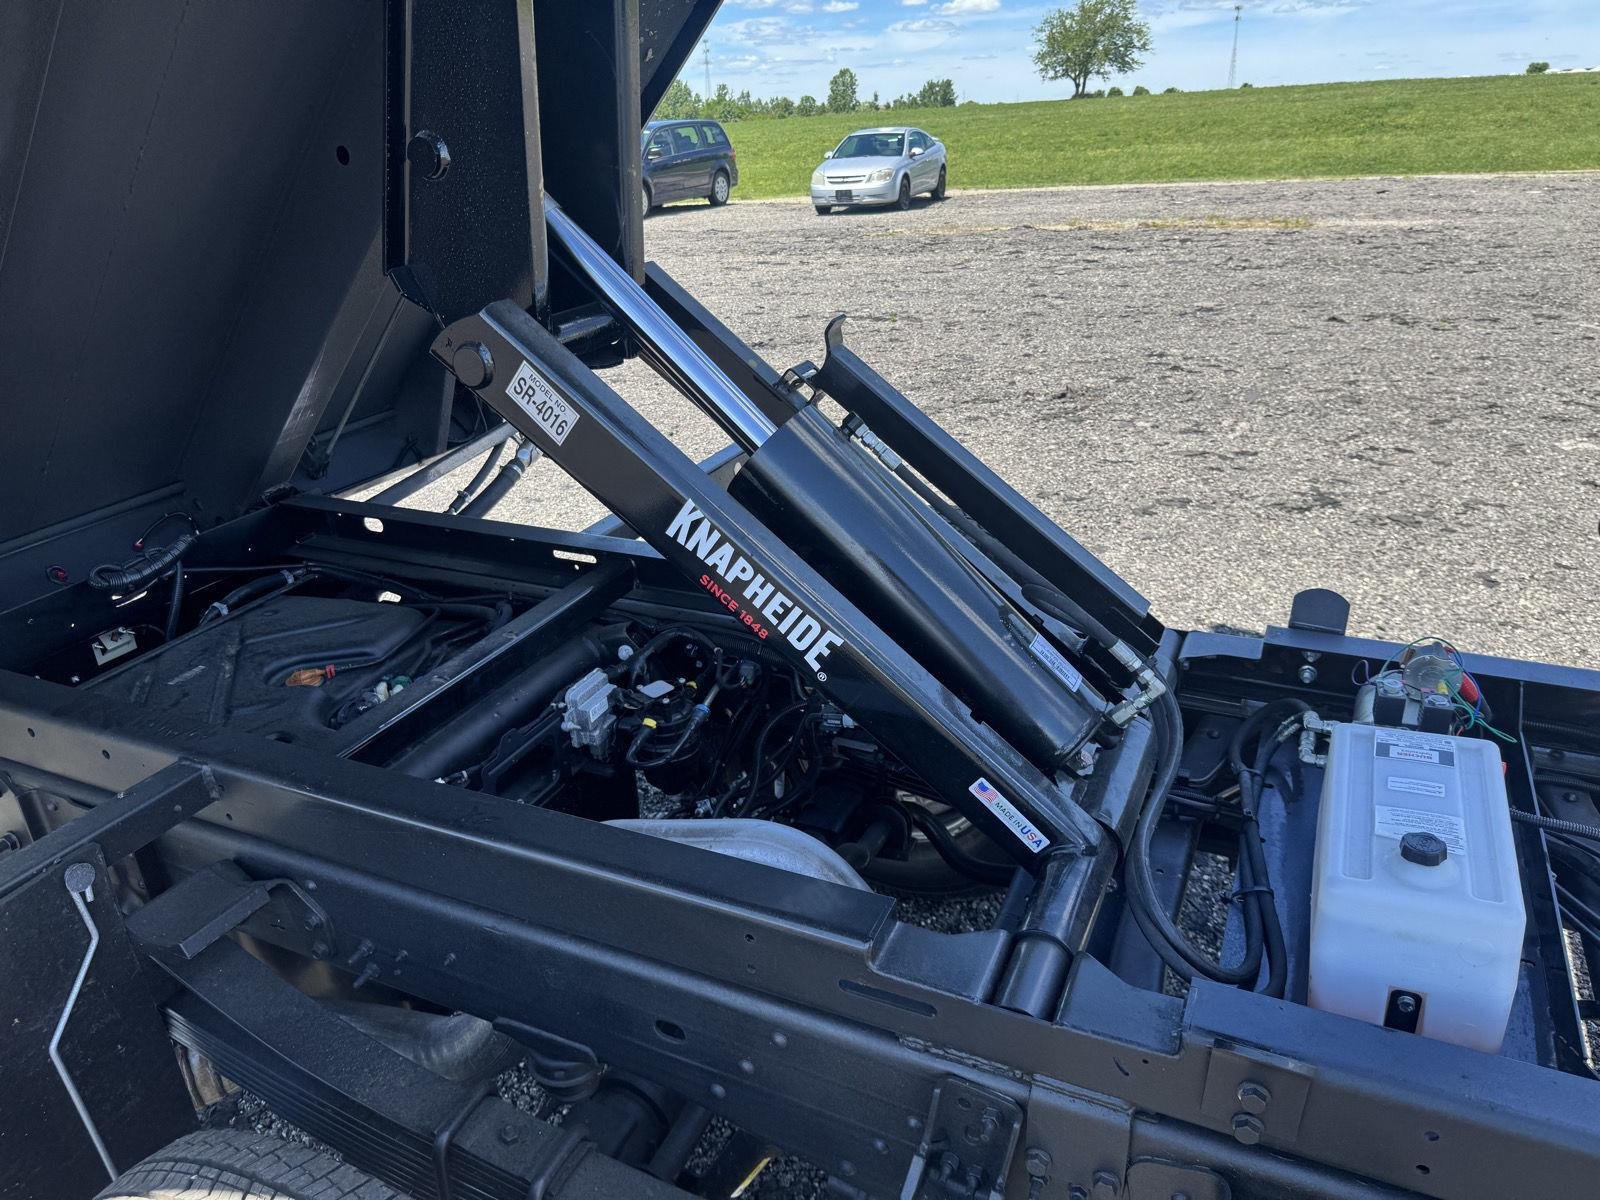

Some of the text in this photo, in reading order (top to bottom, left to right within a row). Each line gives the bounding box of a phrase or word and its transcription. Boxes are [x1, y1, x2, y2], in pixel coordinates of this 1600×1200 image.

[513, 377, 568, 436] SR-4016
[528, 374, 567, 415] MODEL NO.
[699, 574, 769, 640] SINCE 1848
[994, 802, 1042, 848] MADE IN USA
